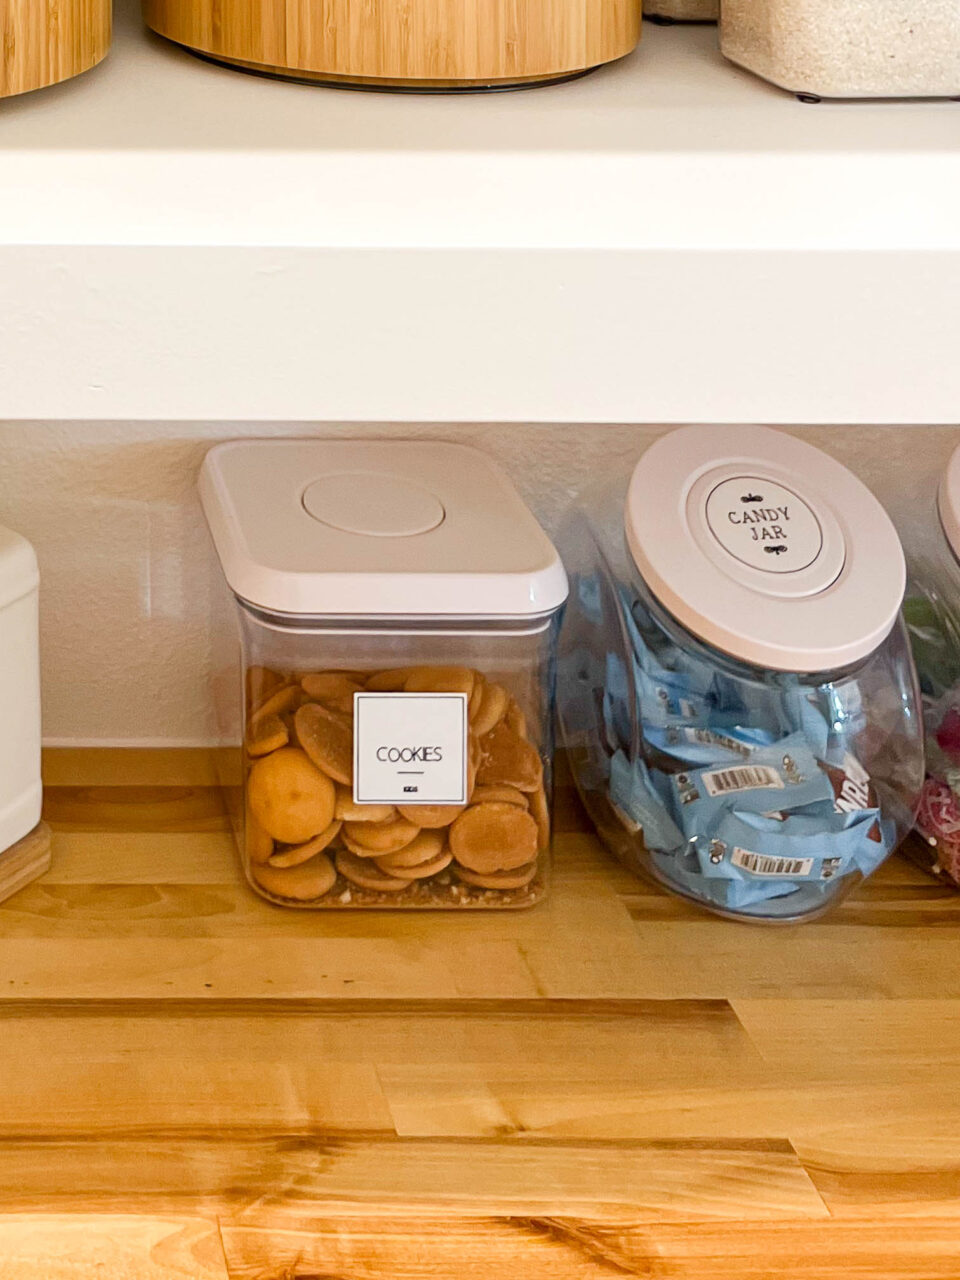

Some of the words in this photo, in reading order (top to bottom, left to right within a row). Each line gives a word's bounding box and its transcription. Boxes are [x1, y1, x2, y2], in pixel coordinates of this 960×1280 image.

[728, 506, 790, 524] CANDY
[750, 525, 787, 541] JAR
[376, 746, 443, 762] COOKIES
